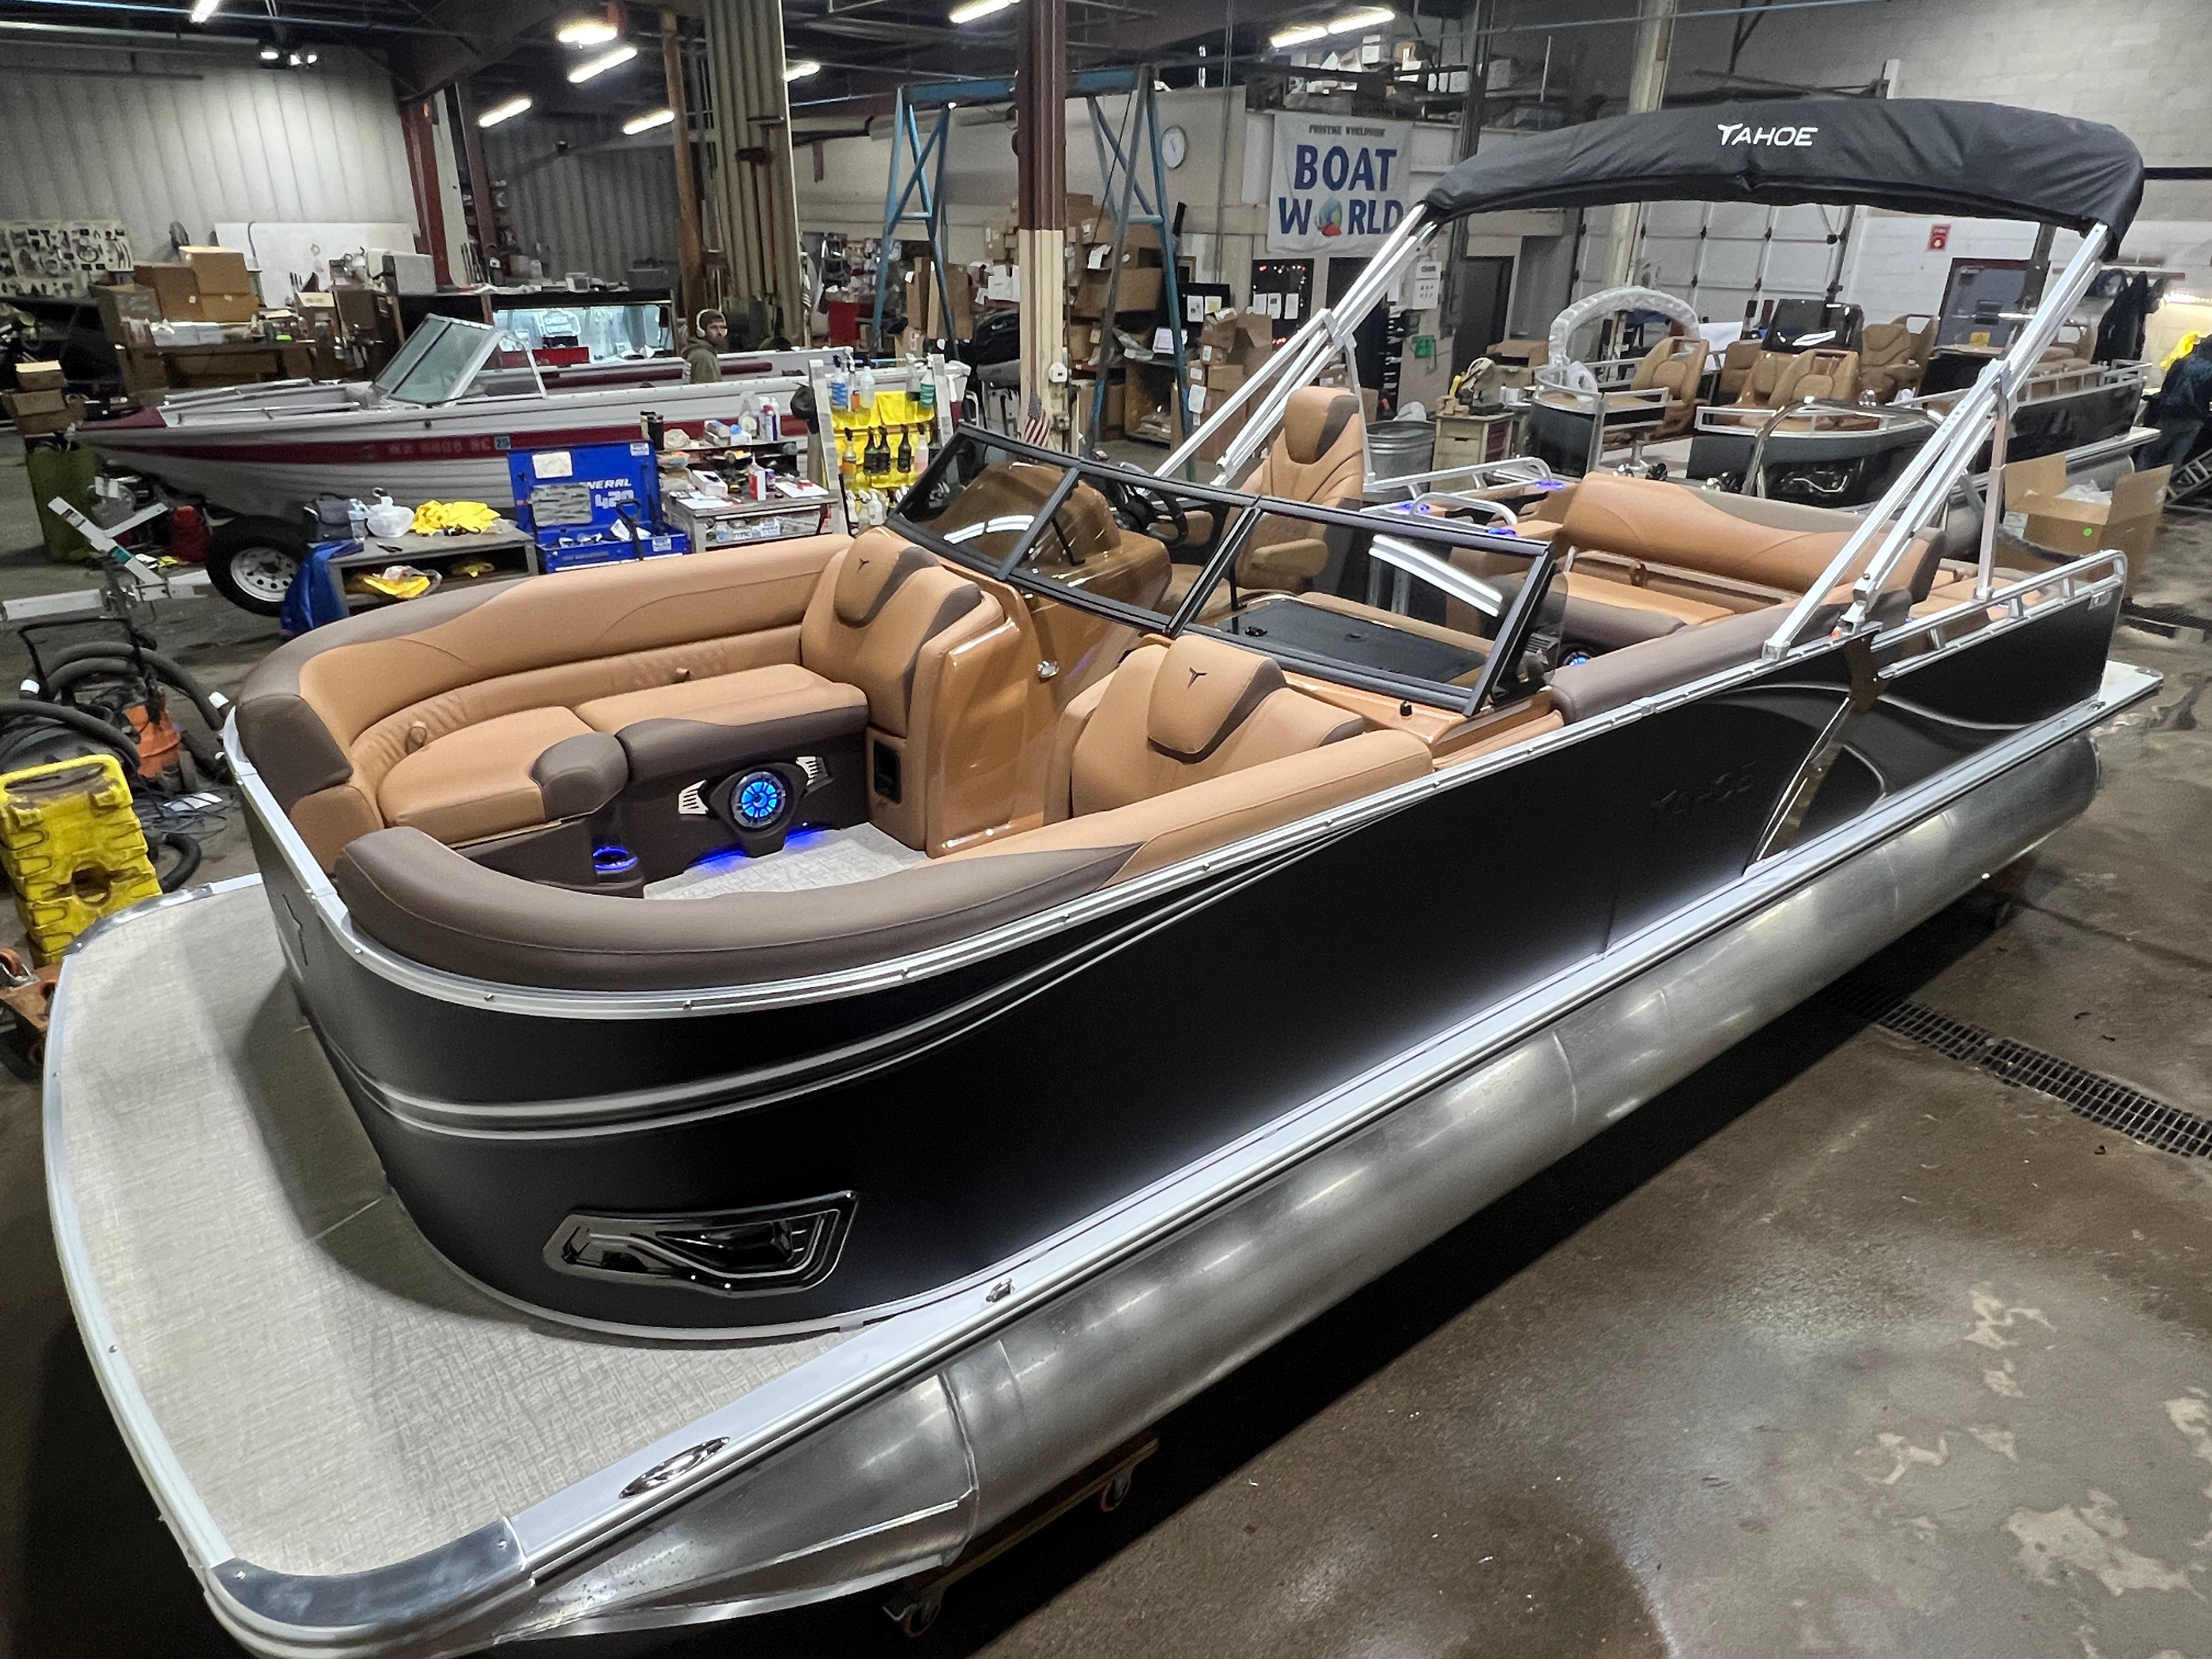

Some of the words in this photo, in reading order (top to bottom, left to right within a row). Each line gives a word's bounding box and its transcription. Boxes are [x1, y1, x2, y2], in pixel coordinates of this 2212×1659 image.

[1717, 123, 1818, 146] TAHOE
[1294, 144, 1397, 191] BOAT
[579, 478, 632, 489] NERAL
